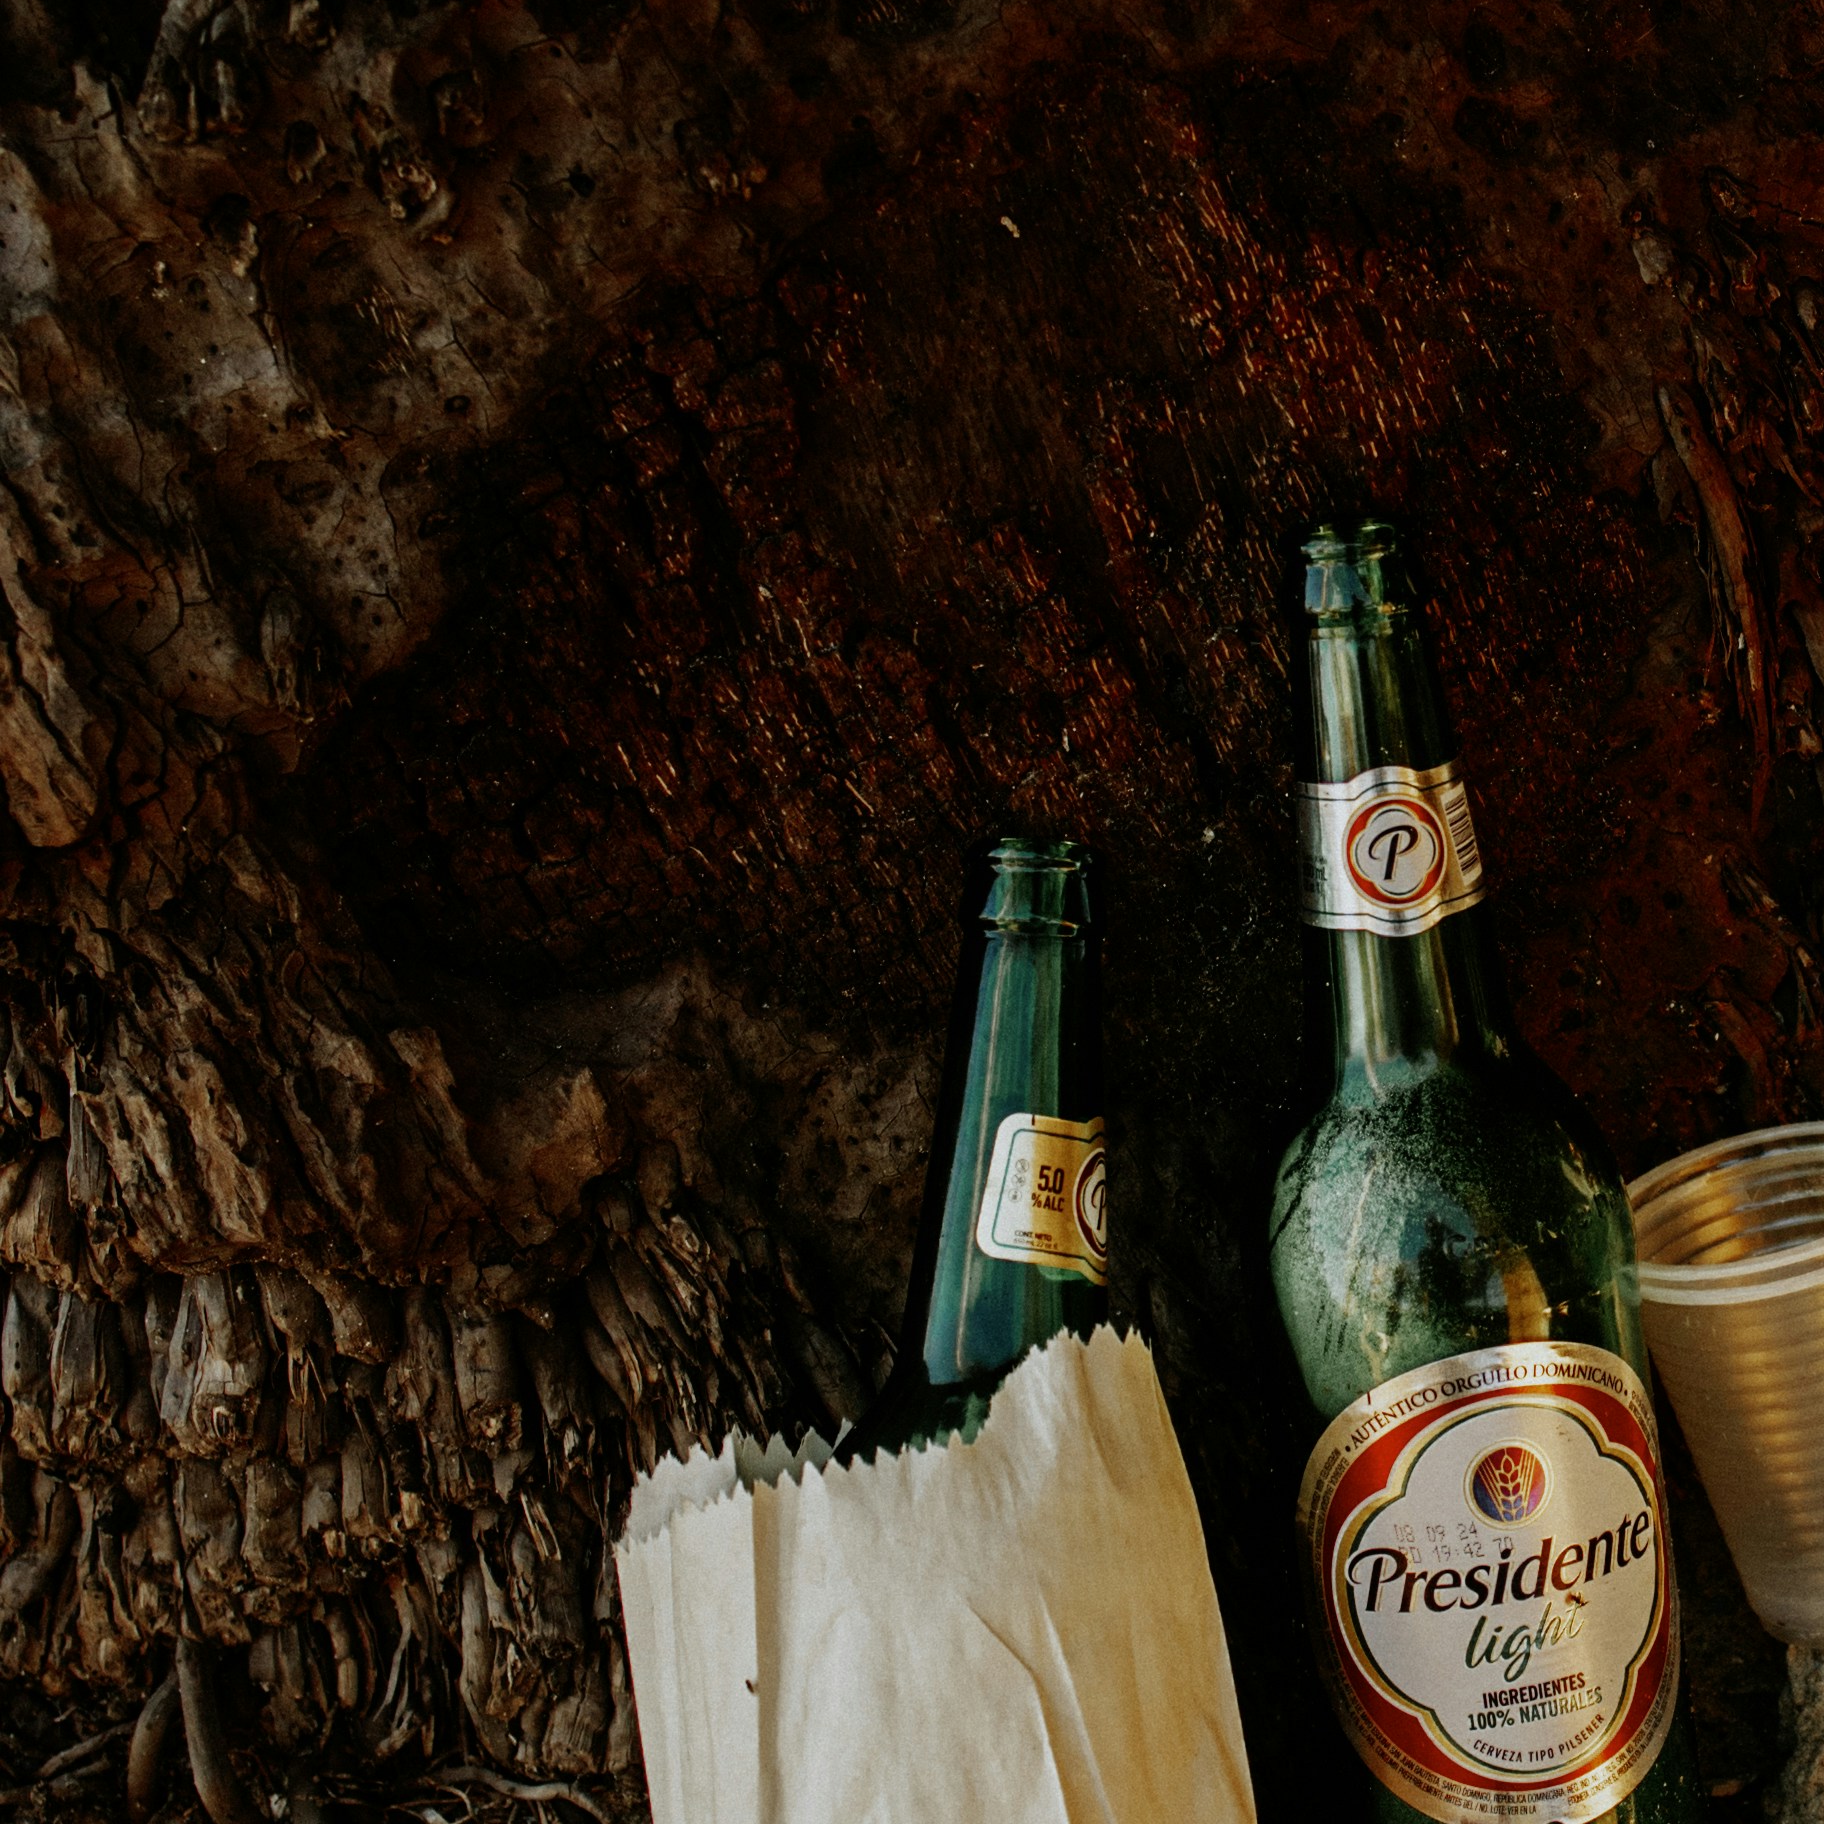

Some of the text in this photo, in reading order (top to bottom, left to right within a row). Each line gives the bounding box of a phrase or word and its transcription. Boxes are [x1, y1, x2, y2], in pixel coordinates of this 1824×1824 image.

[1368, 824, 1420, 881] P
[1038, 1165, 1065, 1194] 5.0
[1043, 1195, 1065, 1213] ALC
[1350, 1362, 1624, 1447] AUTÉNTICO ORGULLO DOMINICANO
[1456, 1521, 1478, 1541] 24
[1347, 1509, 1651, 1614] Presidente
[1464, 1593, 1587, 1682] light
[1467, 1686, 1603, 1731] 100% NATURALES
[1483, 1672, 1586, 1709] INGREDIENTES
[1473, 1713, 1605, 1763] CERVEZA TIPO PILSENER
